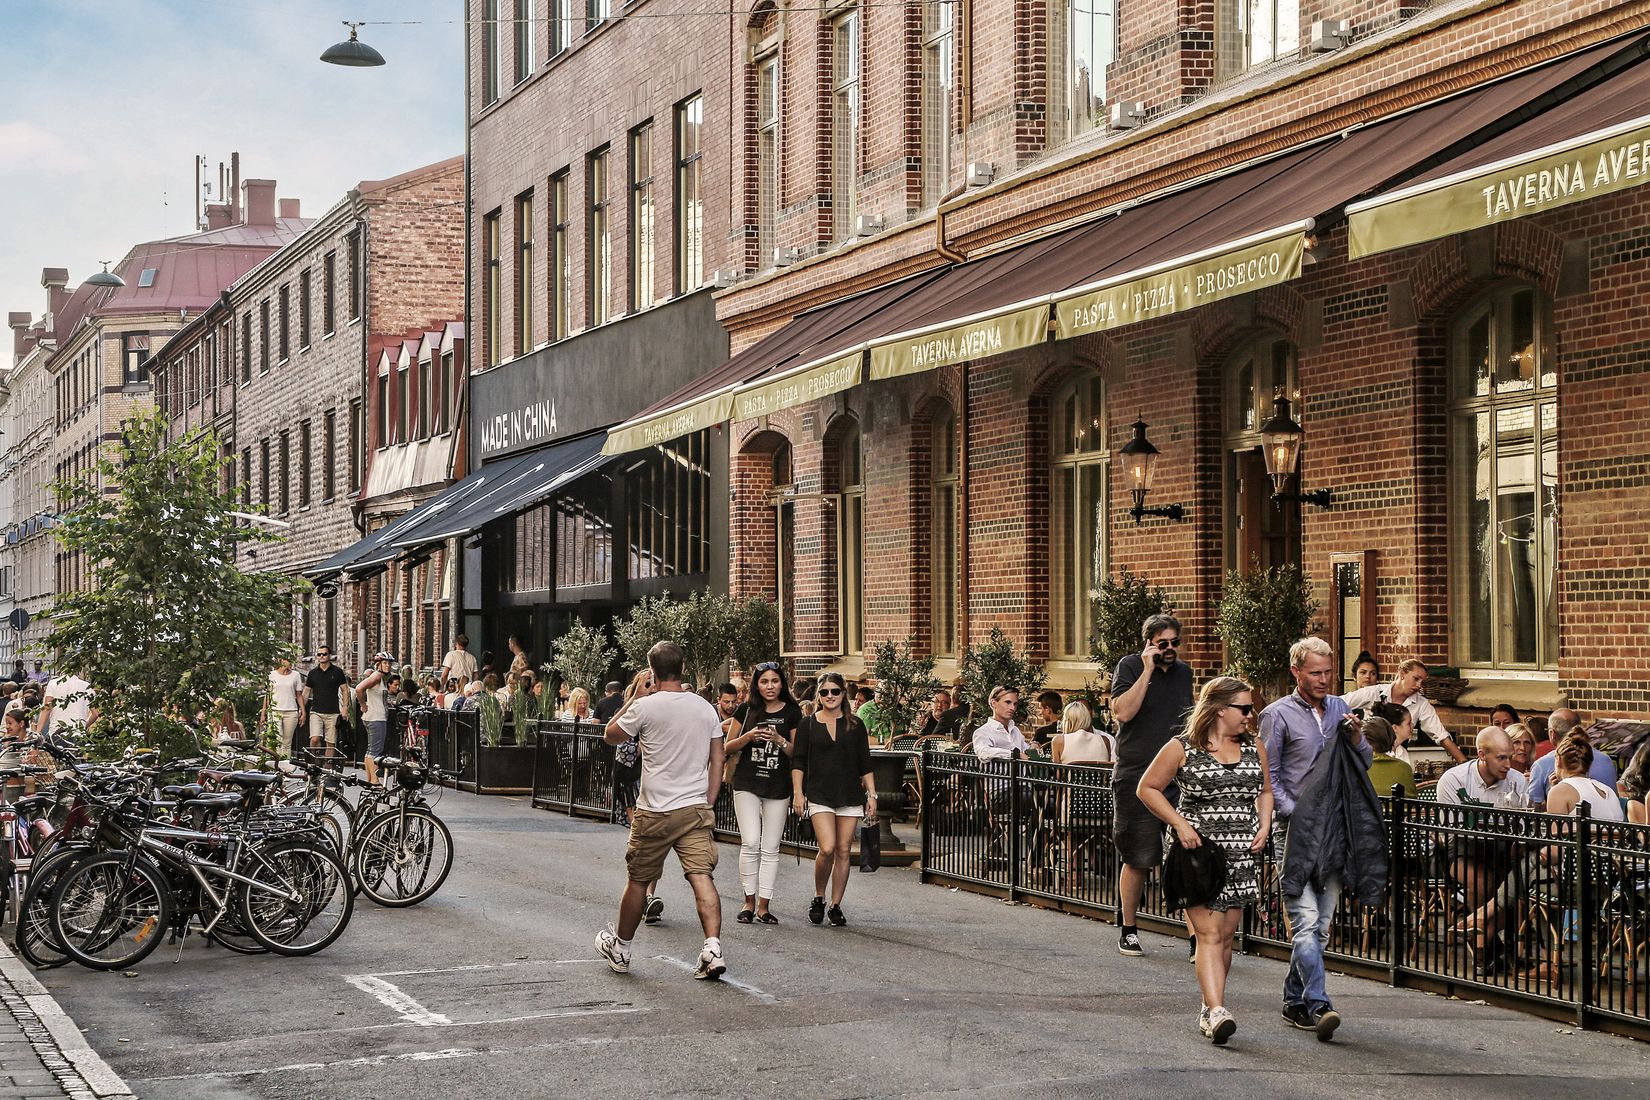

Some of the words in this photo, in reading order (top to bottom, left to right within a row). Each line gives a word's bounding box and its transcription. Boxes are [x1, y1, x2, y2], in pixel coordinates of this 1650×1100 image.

[1482, 160, 1586, 218] TAVERNA
[1073, 300, 1115, 328] PASTA
[1134, 283, 1176, 314] PIZZA
[1196, 252, 1280, 297] PROSECCO
[911, 338, 956, 367] TAVERNA
[959, 326, 1002, 358] AVERNA
[743, 395, 766, 415] PASTA
[776, 384, 799, 405] PIZZA
[807, 366, 851, 395] PROSECCO
[481, 413, 508, 454] MADE
[511, 409, 522, 446] IN
[524, 397, 558, 441] CHINA
